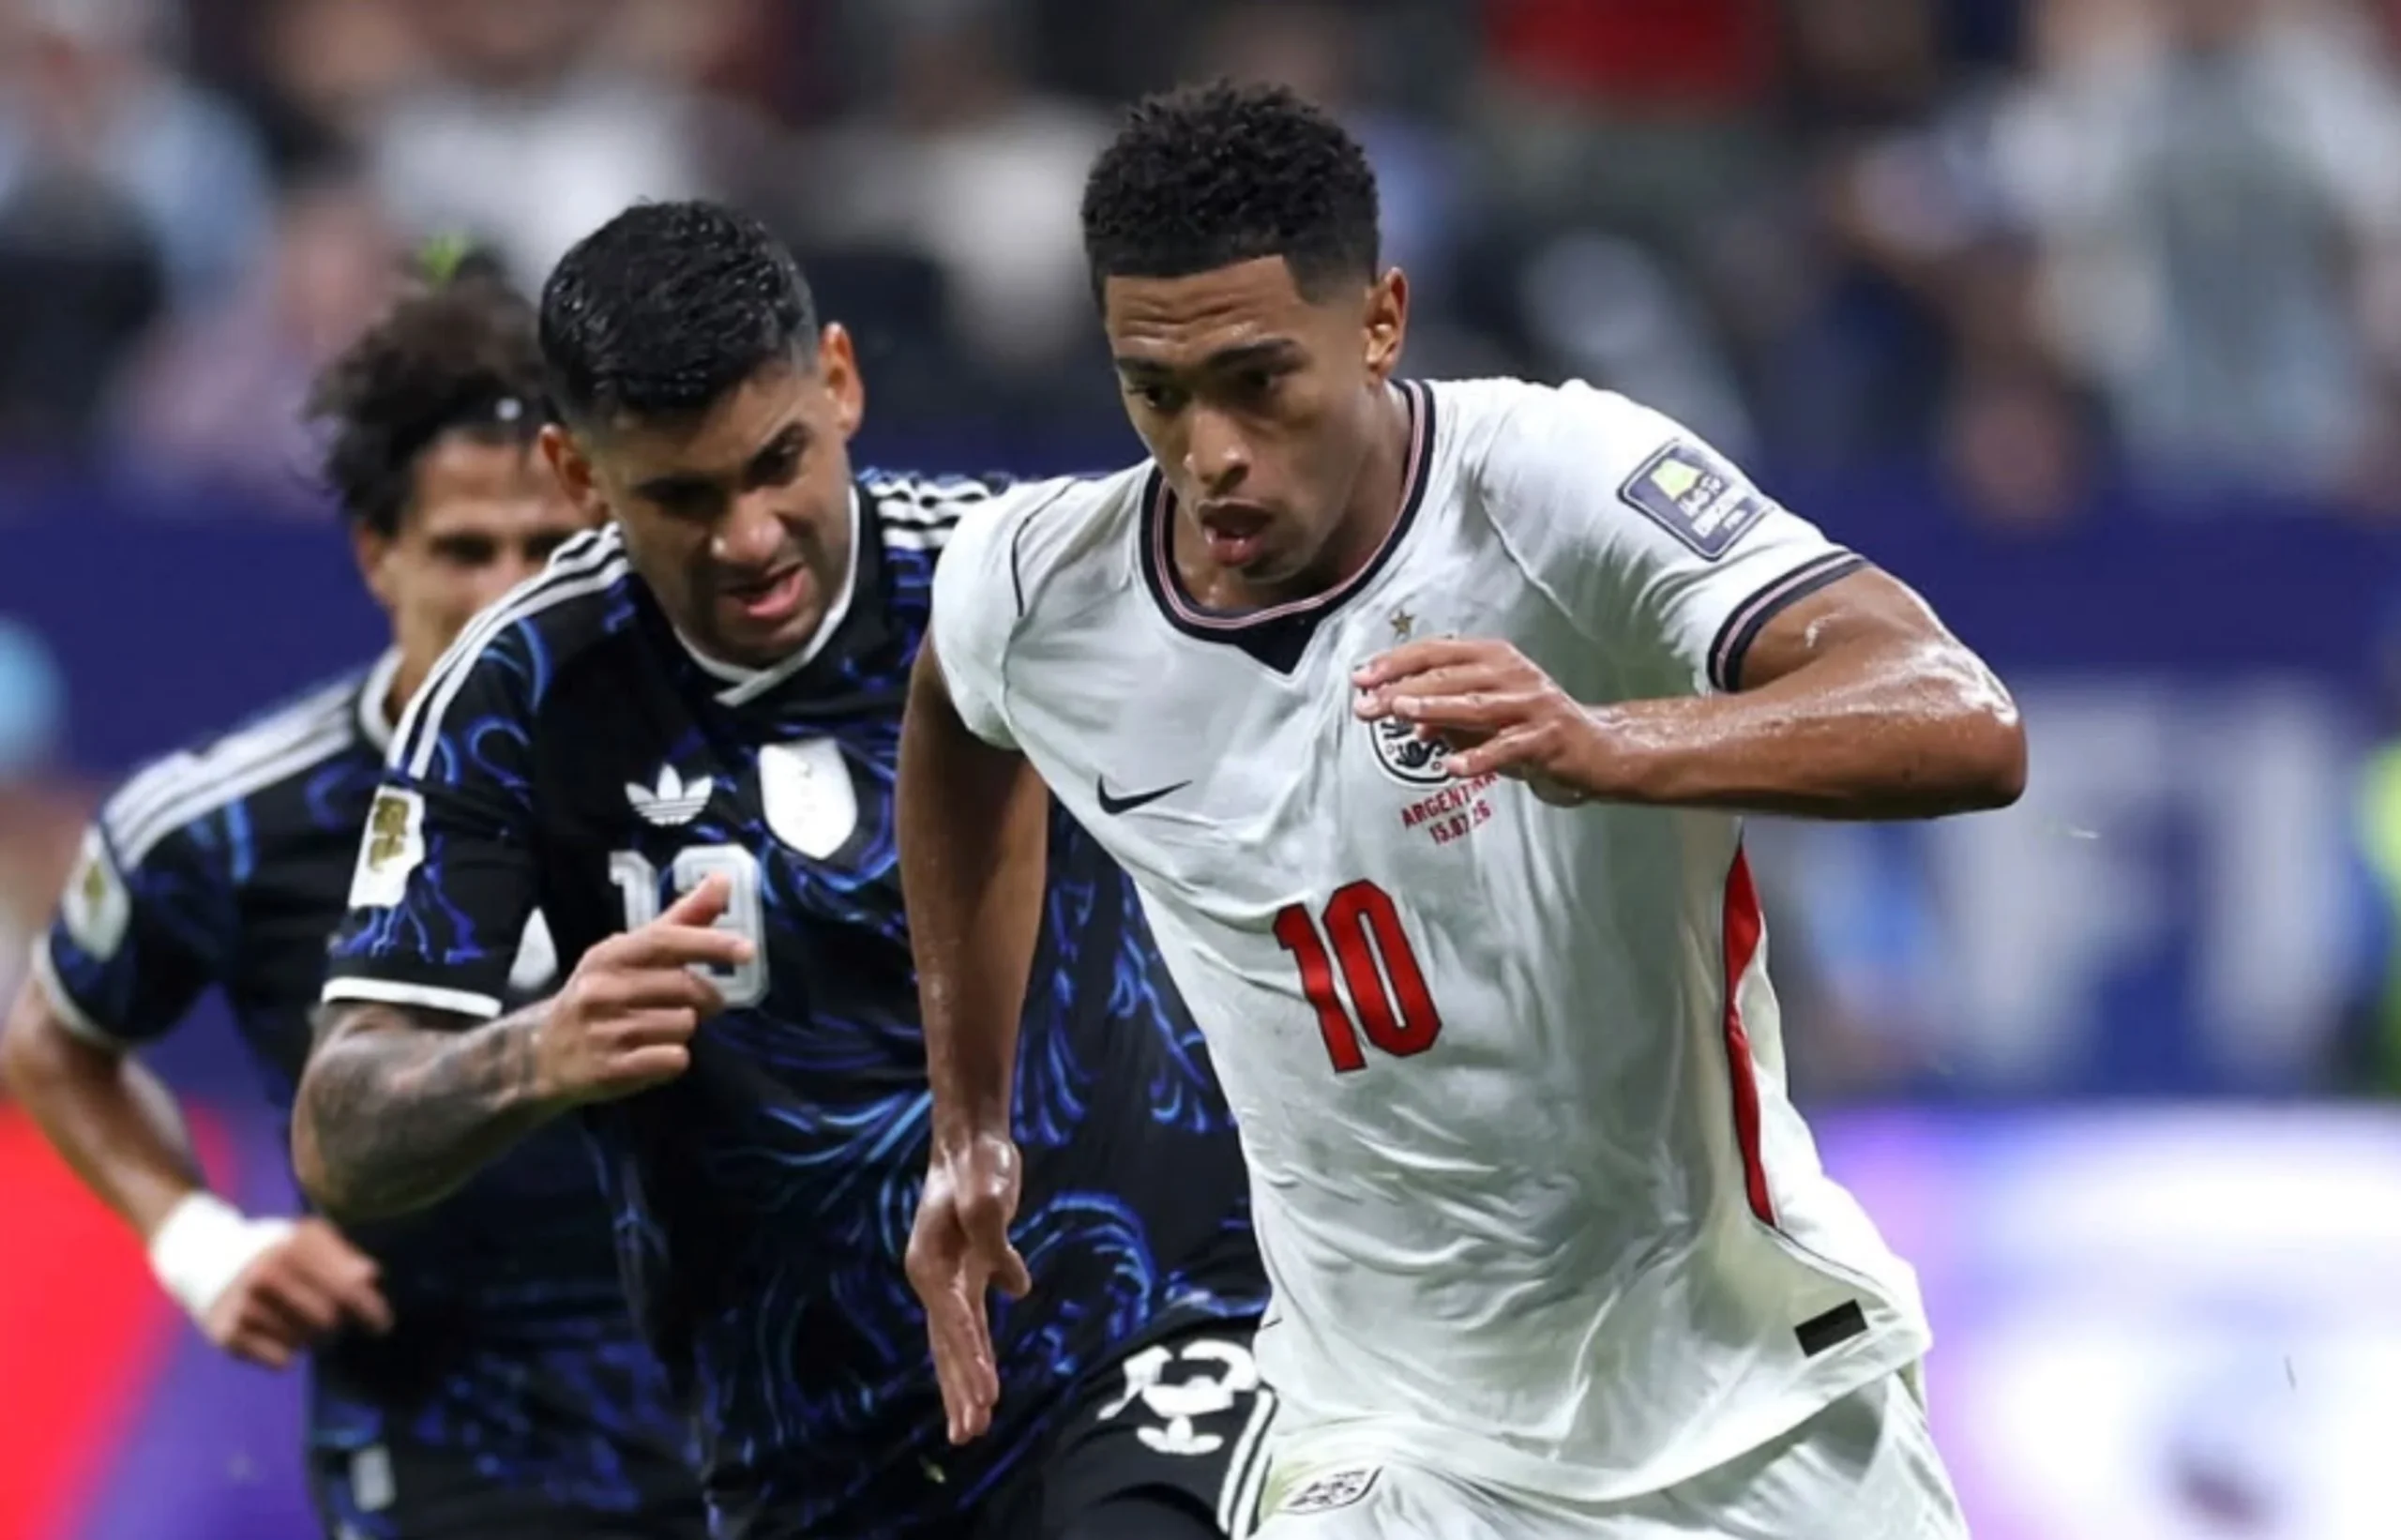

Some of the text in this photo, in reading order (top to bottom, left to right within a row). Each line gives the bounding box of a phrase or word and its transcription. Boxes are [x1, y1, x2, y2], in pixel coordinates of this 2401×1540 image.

[1401, 771, 1498, 829] ARGENTNA
[1429, 800, 1491, 844] 15.0726
[1272, 879, 1443, 1074] 10
